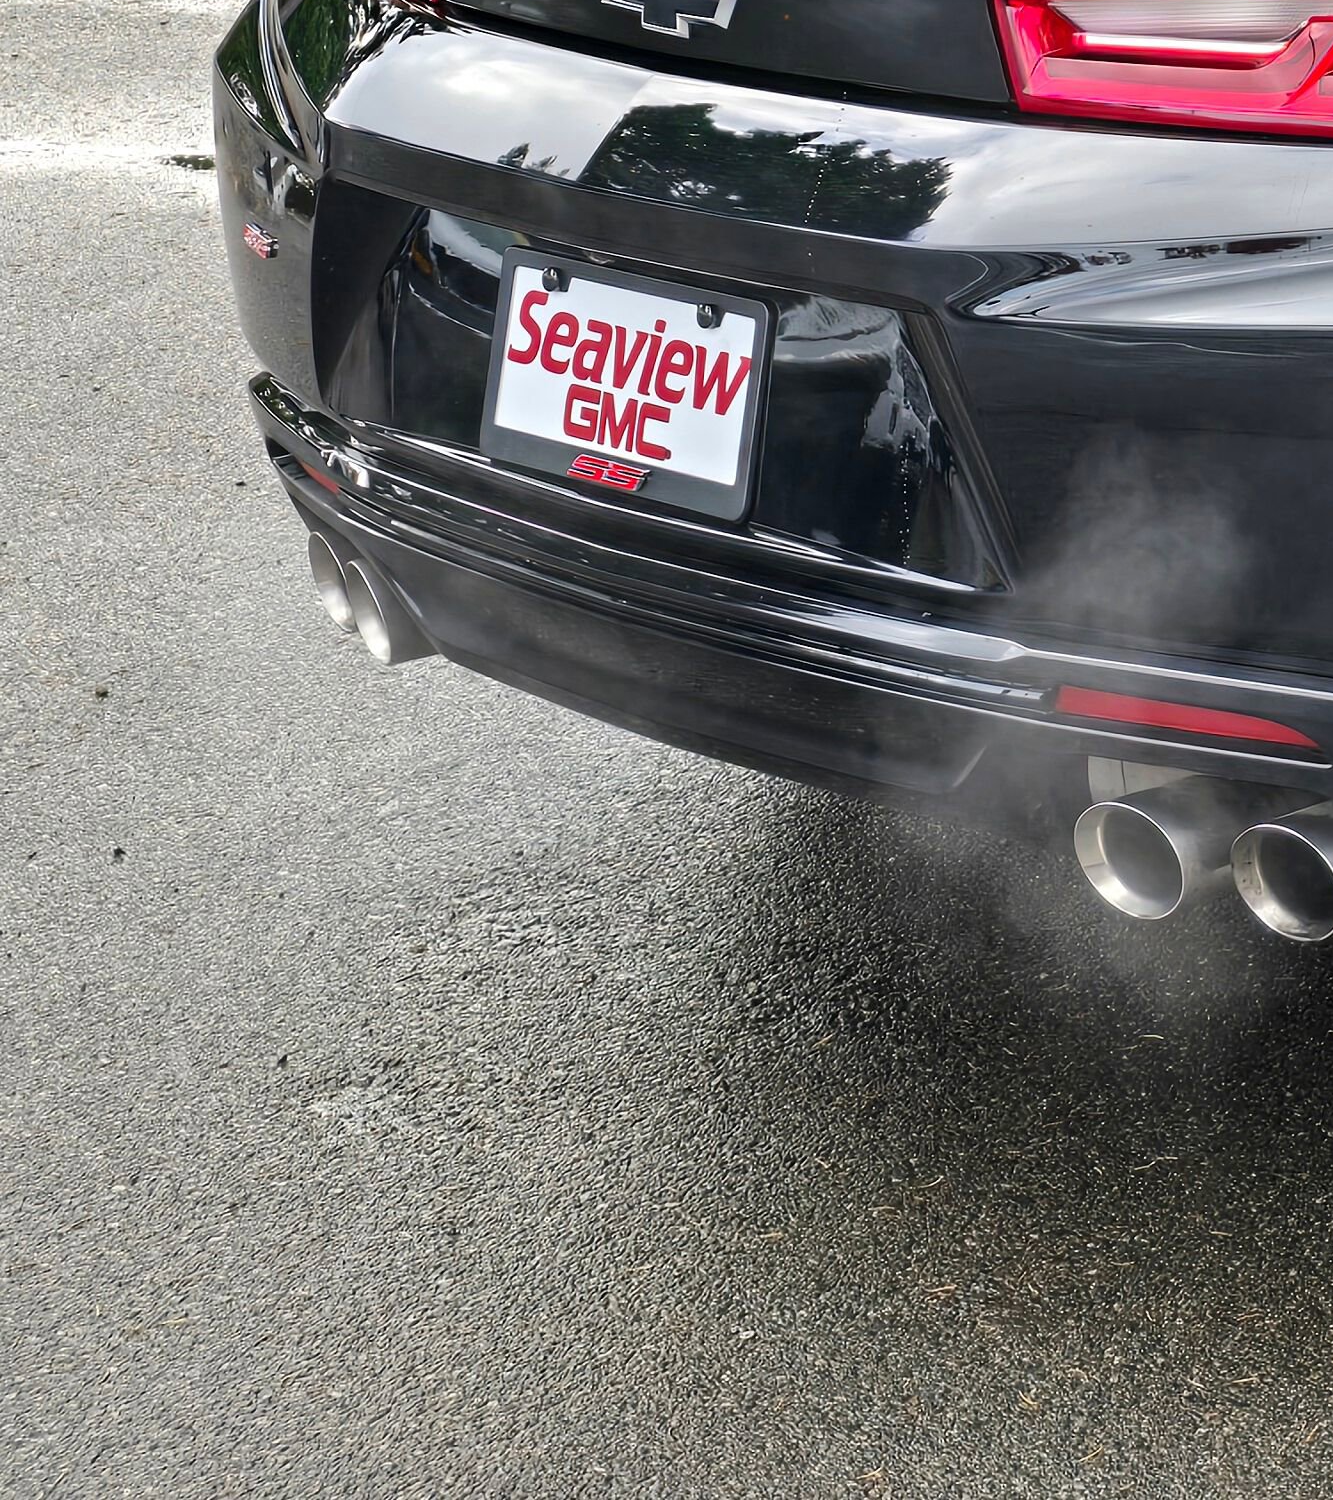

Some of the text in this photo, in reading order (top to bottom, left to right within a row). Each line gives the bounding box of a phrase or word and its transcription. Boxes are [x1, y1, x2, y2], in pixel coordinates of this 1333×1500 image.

[507, 290, 752, 416] Seaview
[563, 384, 671, 461] GMC
[566, 453, 651, 492] SS
